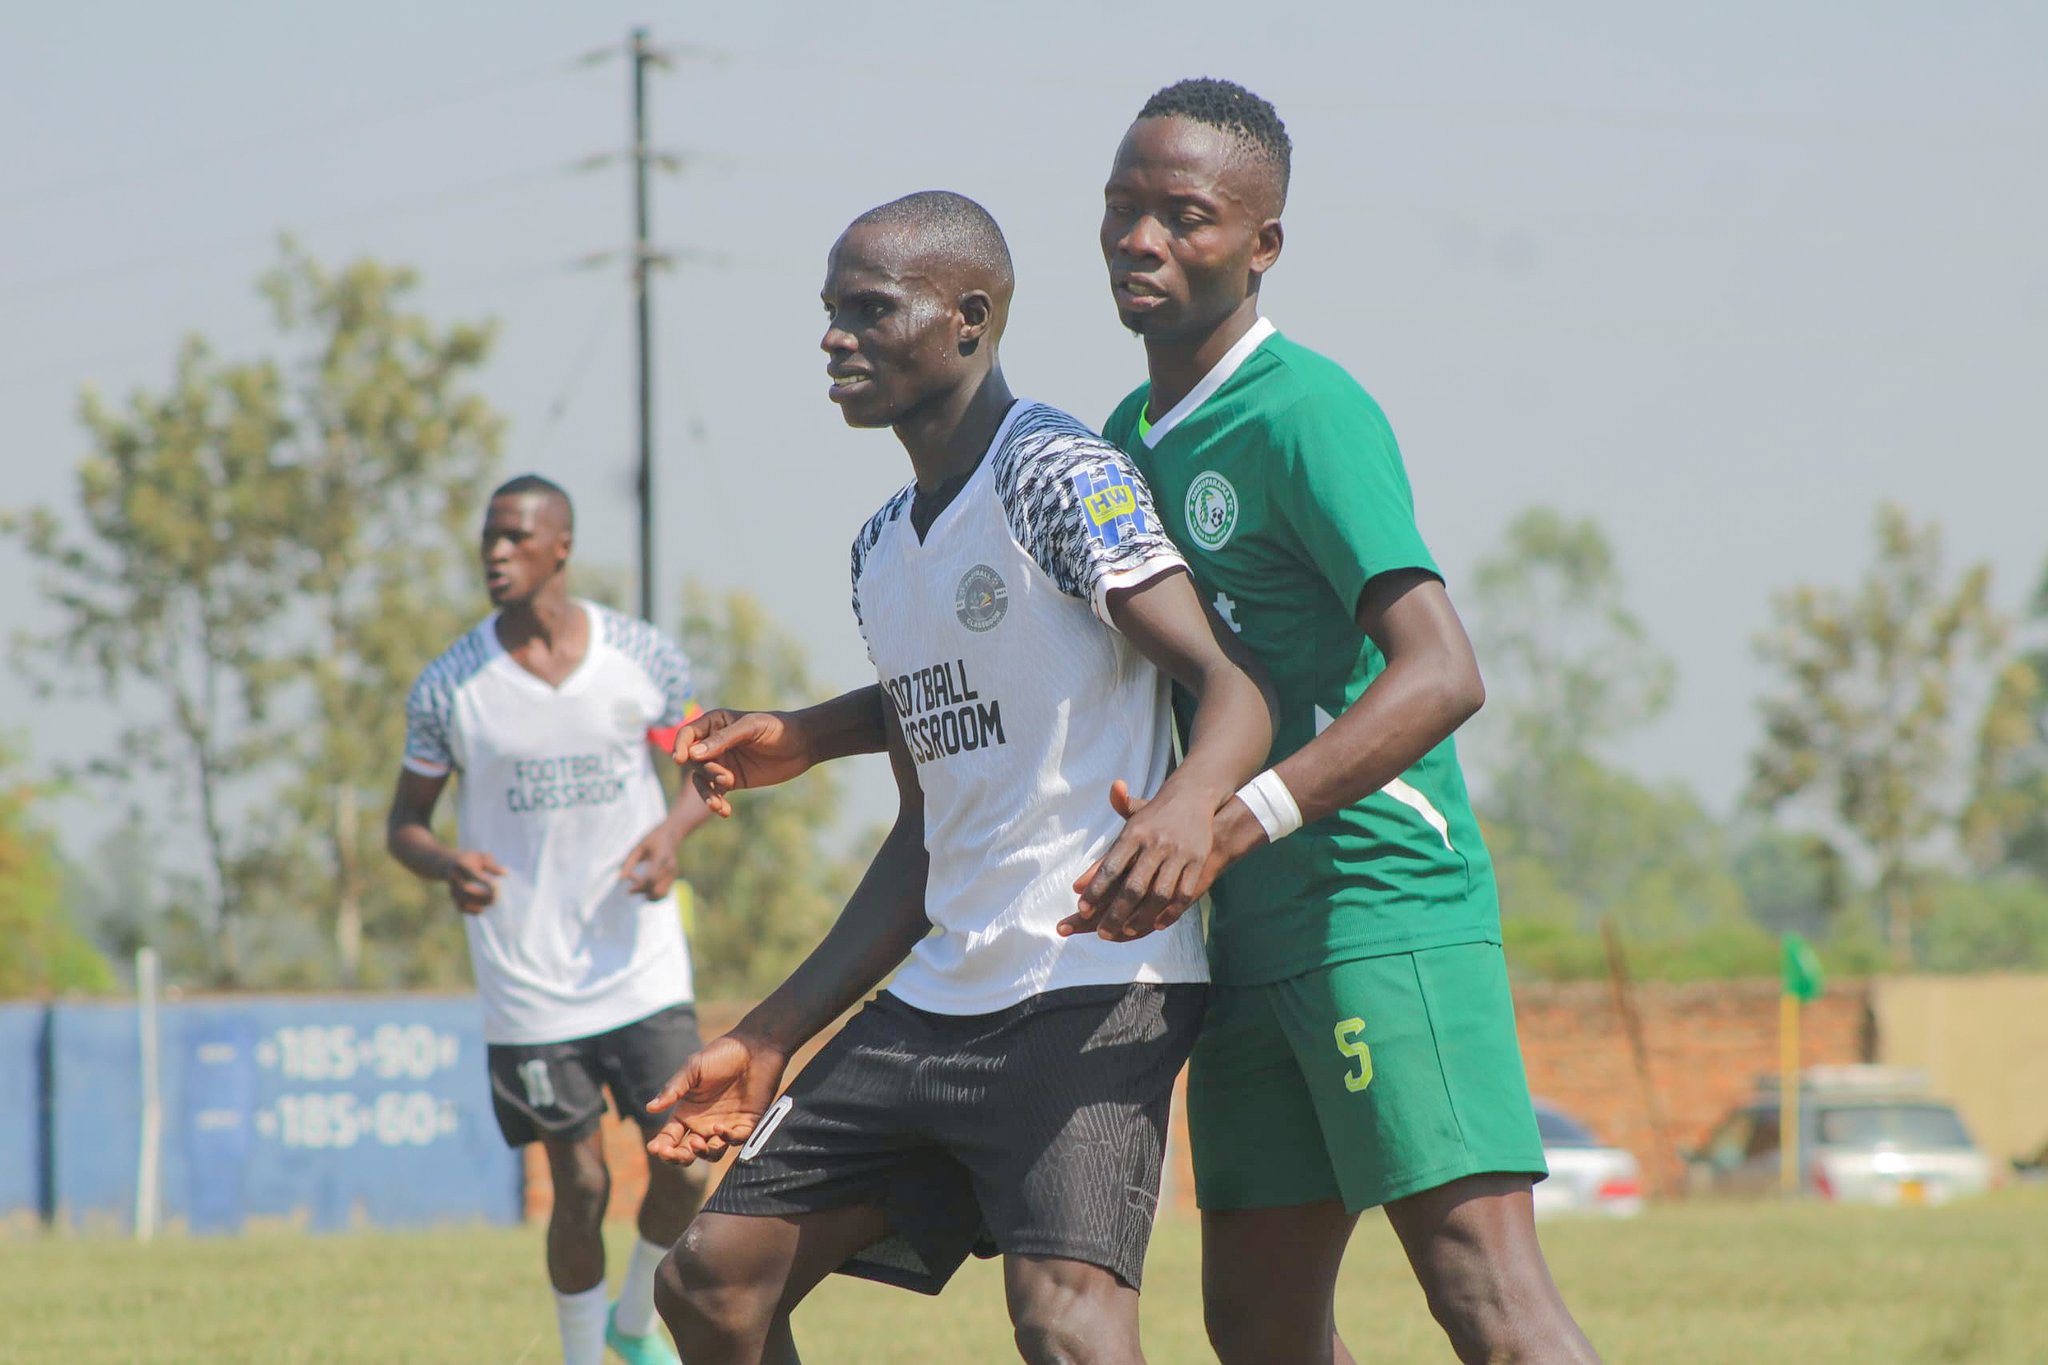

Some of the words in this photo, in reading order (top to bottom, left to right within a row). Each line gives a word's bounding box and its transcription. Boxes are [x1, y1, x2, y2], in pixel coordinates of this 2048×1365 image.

[1090, 487, 1130, 514] HW
[884, 658, 979, 718] OOTBALL
[904, 699, 1006, 766] ASSROOM
[515, 752, 616, 784] FOOTBALL
[507, 778, 625, 814] CLASSROOM
[1333, 1016, 1374, 1092] 5
